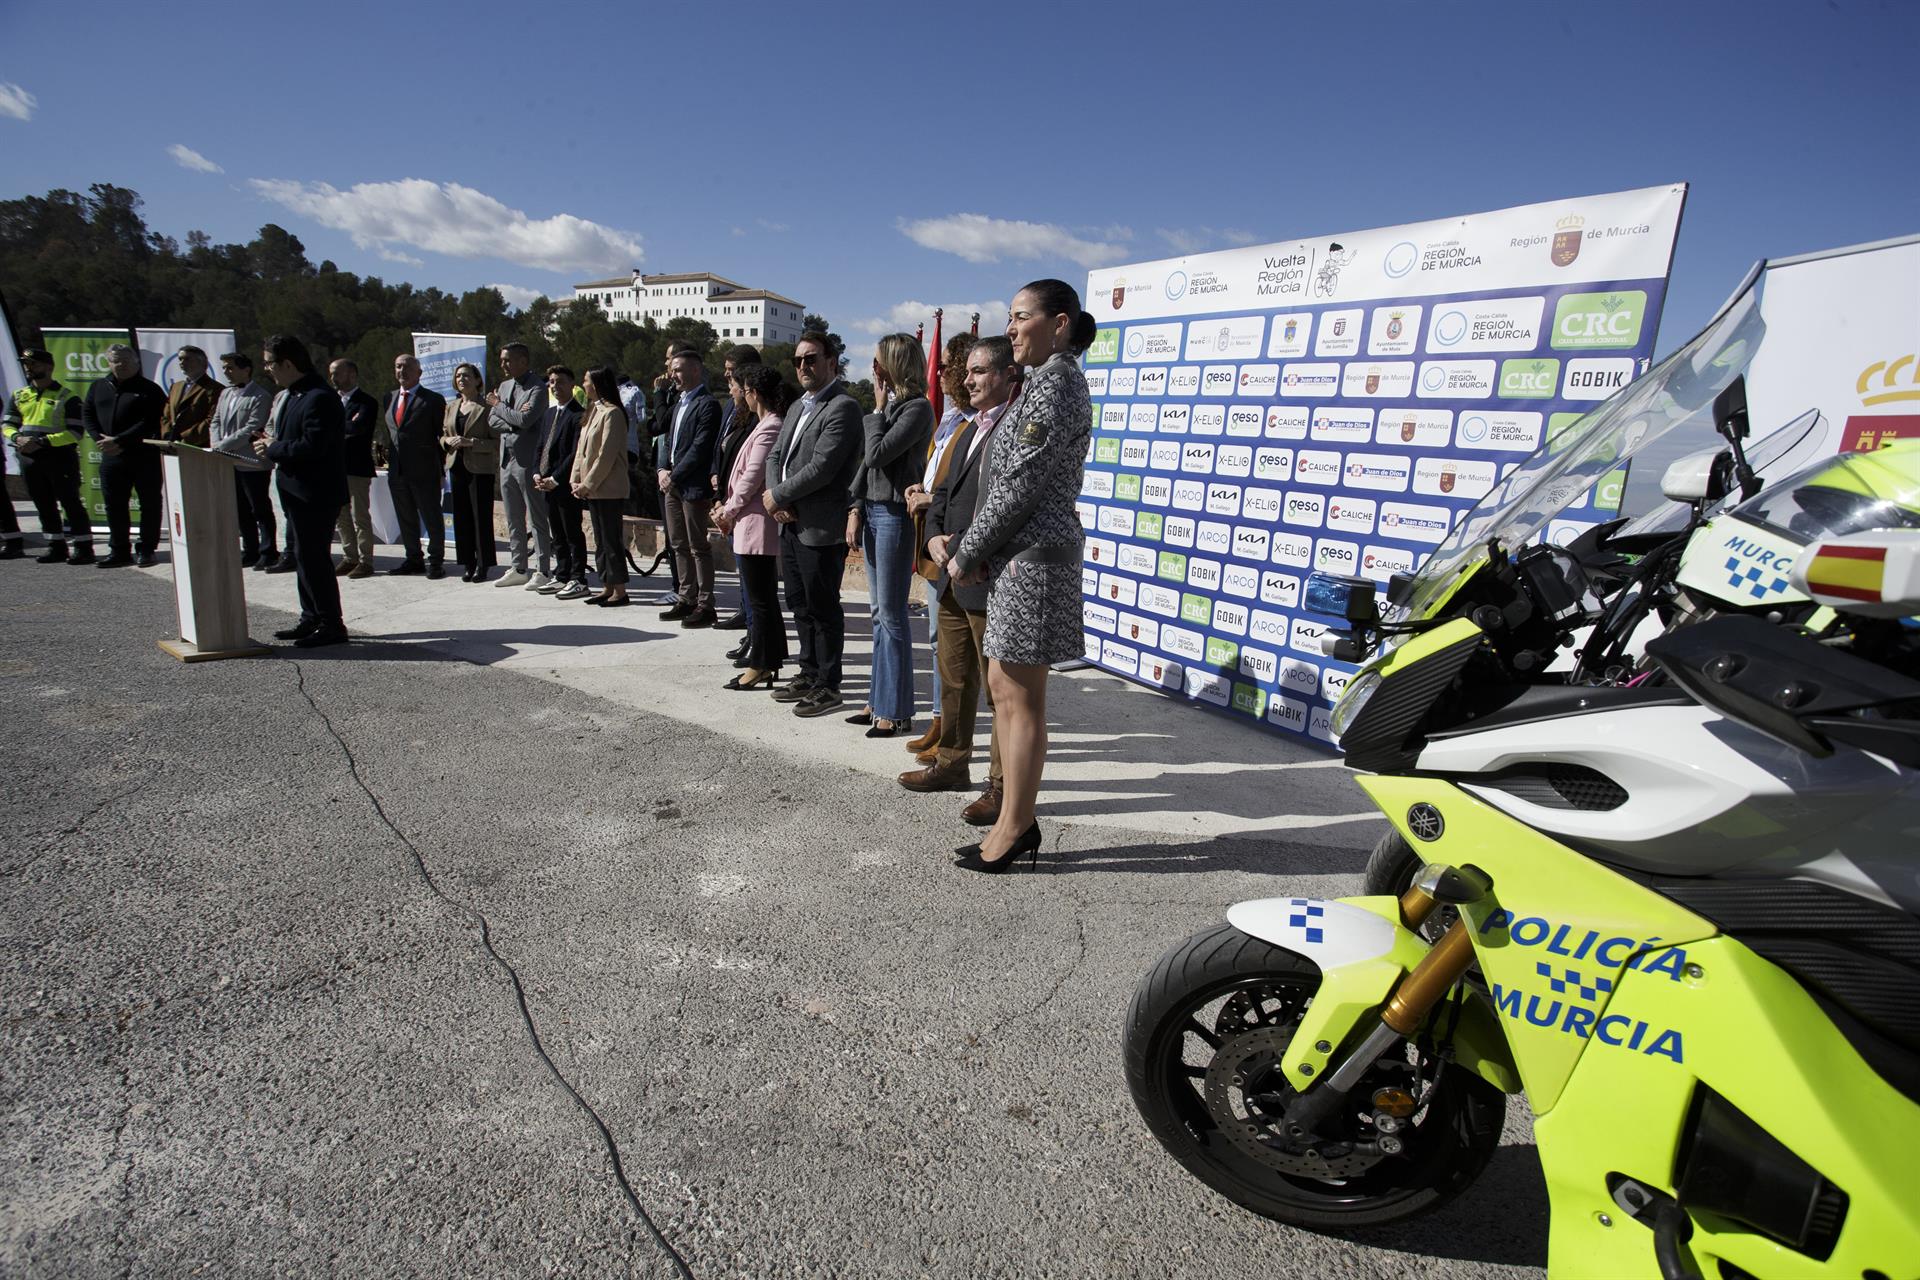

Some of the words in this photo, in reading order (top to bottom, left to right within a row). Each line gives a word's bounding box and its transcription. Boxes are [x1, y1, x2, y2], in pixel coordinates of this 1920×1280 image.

[1510, 235, 1547, 248] Región
[1587, 229, 1602, 240] de
[1606, 224, 1650, 237] Murcia
[1264, 254, 1306, 268] Vuelta
[1422, 260, 1436, 271] DE
[1440, 256, 1482, 270] MURCIA
[1258, 267, 1304, 283] Región
[1200, 284, 1228, 294] MURCIA
[1257, 281, 1300, 296] Murcia
[1560, 311, 1632, 336] CRC
[1472, 332, 1488, 340] DE
[1492, 330, 1531, 340] MURCIA
[1090, 341, 1114, 356] CRC
[1154, 346, 1176, 354] MURCIA
[1112, 377, 1134, 386] ARCO
[1170, 376, 1198, 386] X-ELIO
[1206, 372, 1232, 390] gesa
[1250, 376, 1276, 384] CALICHE
[1504, 372, 1551, 390] CRC
[1570, 372, 1624, 387] GOBIK
[1104, 412, 1124, 422] GOBIK
[1132, 413, 1156, 423] ARCO
[1194, 415, 1222, 426] X-ELIO
[1231, 413, 1258, 430] gesa
[1278, 418, 1306, 426] CALICHE
[1502, 434, 1534, 442] MURCIA
[1098, 447, 1116, 458] CRC
[1124, 448, 1145, 458] GOBIK
[1152, 451, 1178, 460] ARCO
[1218, 456, 1249, 466] X-ELIO
[1259, 455, 1288, 472] gesa
[1309, 463, 1338, 472] CALICHE
[1418, 470, 1438, 479] Región
[1468, 474, 1492, 482] Murcia
[1118, 483, 1136, 495] CRC
[1145, 485, 1167, 498] GOBIK
[1175, 490, 1202, 500] ARCO
[1246, 498, 1278, 510] X-ELIO
[1288, 500, 1318, 516] gesa
[1341, 510, 1373, 520] CALICHE
[1138, 522, 1159, 534] CRC
[1168, 525, 1190, 538] GOBIK
[1200, 531, 1228, 544] ARCO
[1274, 542, 1308, 558] X-ELIO
[1320, 547, 1352, 564] gesa
[1724, 536, 1792, 574] MURC
[1160, 561, 1182, 576] CRC
[1376, 560, 1409, 571] CALICHE
[1192, 566, 1216, 581] GOBIK
[1225, 575, 1256, 588] ARCO
[1184, 602, 1208, 618] CRC
[1217, 610, 1243, 626] GOBIK
[1252, 620, 1284, 636] ARCO
[1208, 648, 1234, 662] CRC
[1244, 656, 1272, 673] GOBIK
[1282, 668, 1316, 684] ARCO
[1272, 704, 1301, 722] GOBIK
[1480, 908, 1687, 982] POLICÍA
[1492, 984, 1684, 1064] MURCIA
